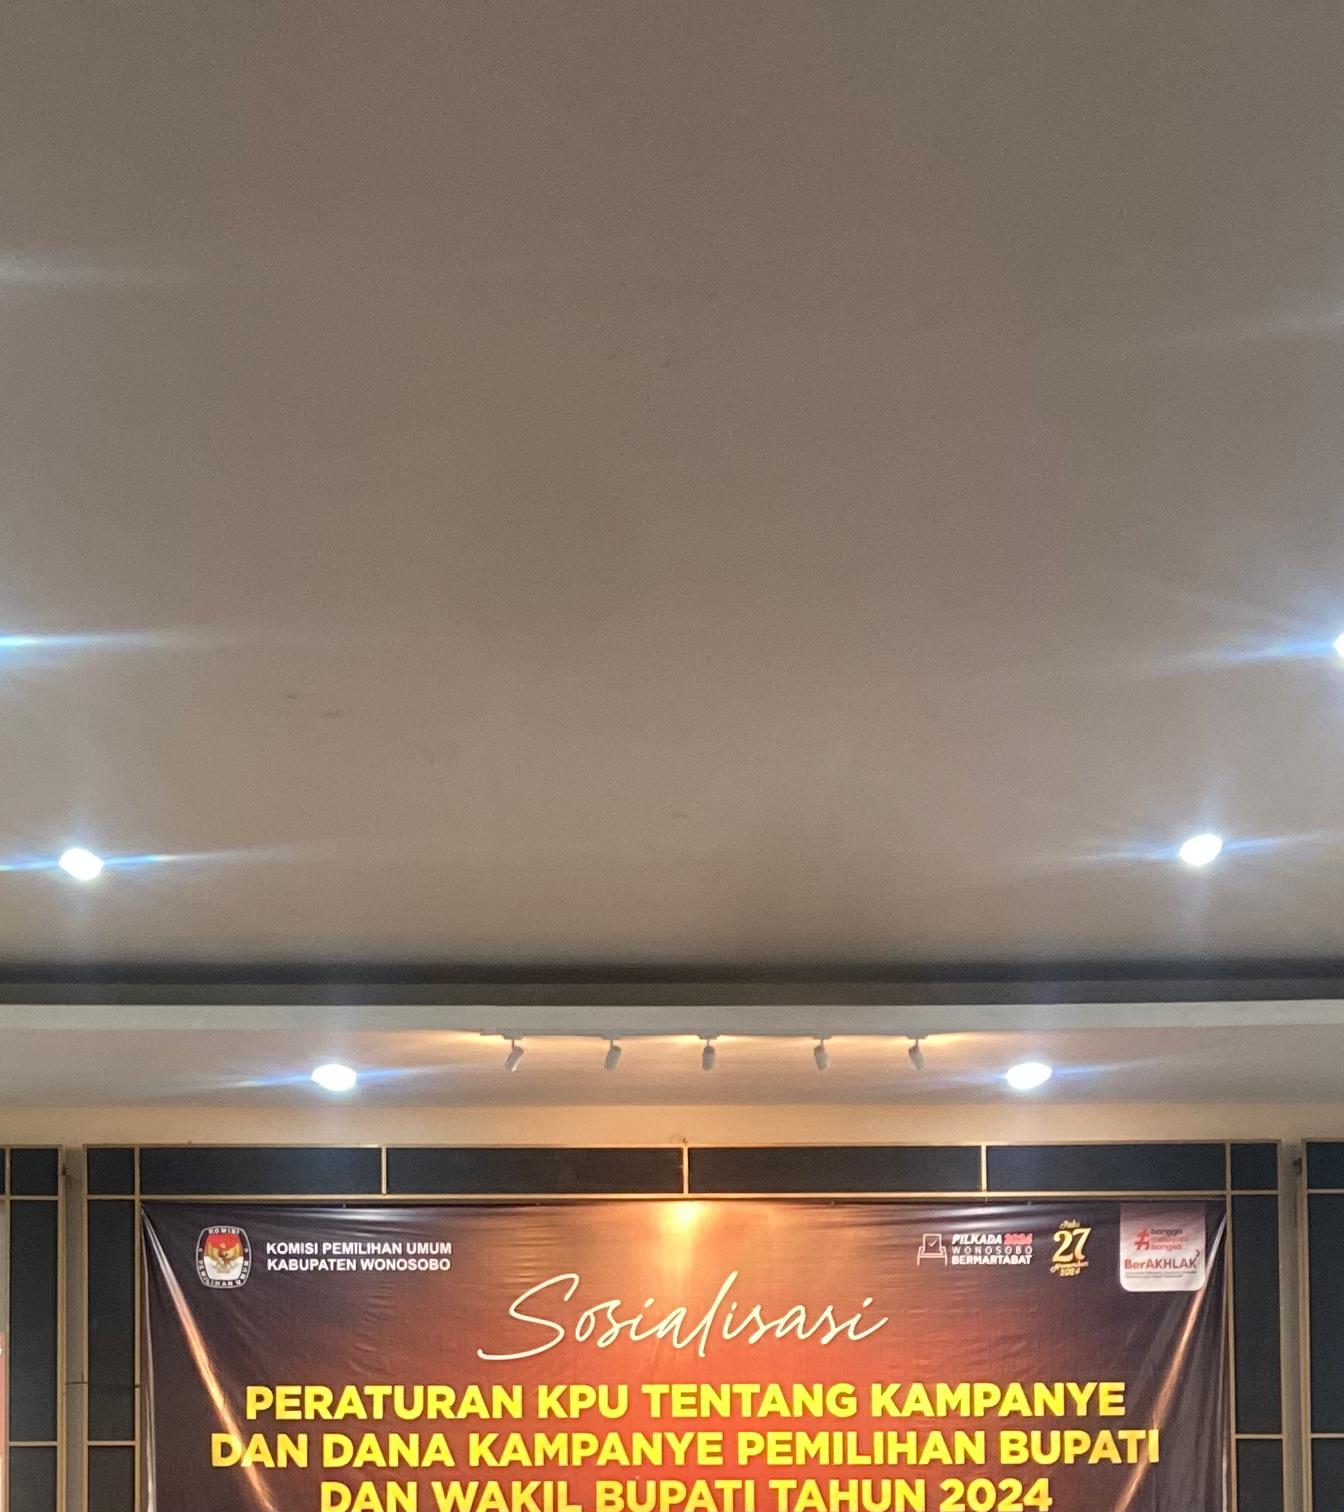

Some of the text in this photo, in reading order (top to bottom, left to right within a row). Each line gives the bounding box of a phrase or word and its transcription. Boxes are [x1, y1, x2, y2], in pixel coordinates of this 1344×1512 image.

[265, 1242, 452, 1255] KOMISI PEMILIHAN UMUM
[951, 1233, 1002, 1245] PILKADA
[1052, 1227, 1092, 1263] 27
[951, 1255, 1032, 1265] BERMARTABAT
[952, 1246, 1033, 1255] WONOSOBO
[1124, 1250, 1200, 1269] BerAKHLAK
[267, 1258, 451, 1271] KABUPATEN WONOSOBO
[476, 1270, 889, 1361] Sosialisasi
[246, 1382, 1125, 1420] PERATURAN KPU TENTANG KAMPANYE
[211, 1429, 1160, 1468] DAN DANA KAMPANYE PEMILIHAN BUPATI
[939, 1477, 1053, 1512] 2024
